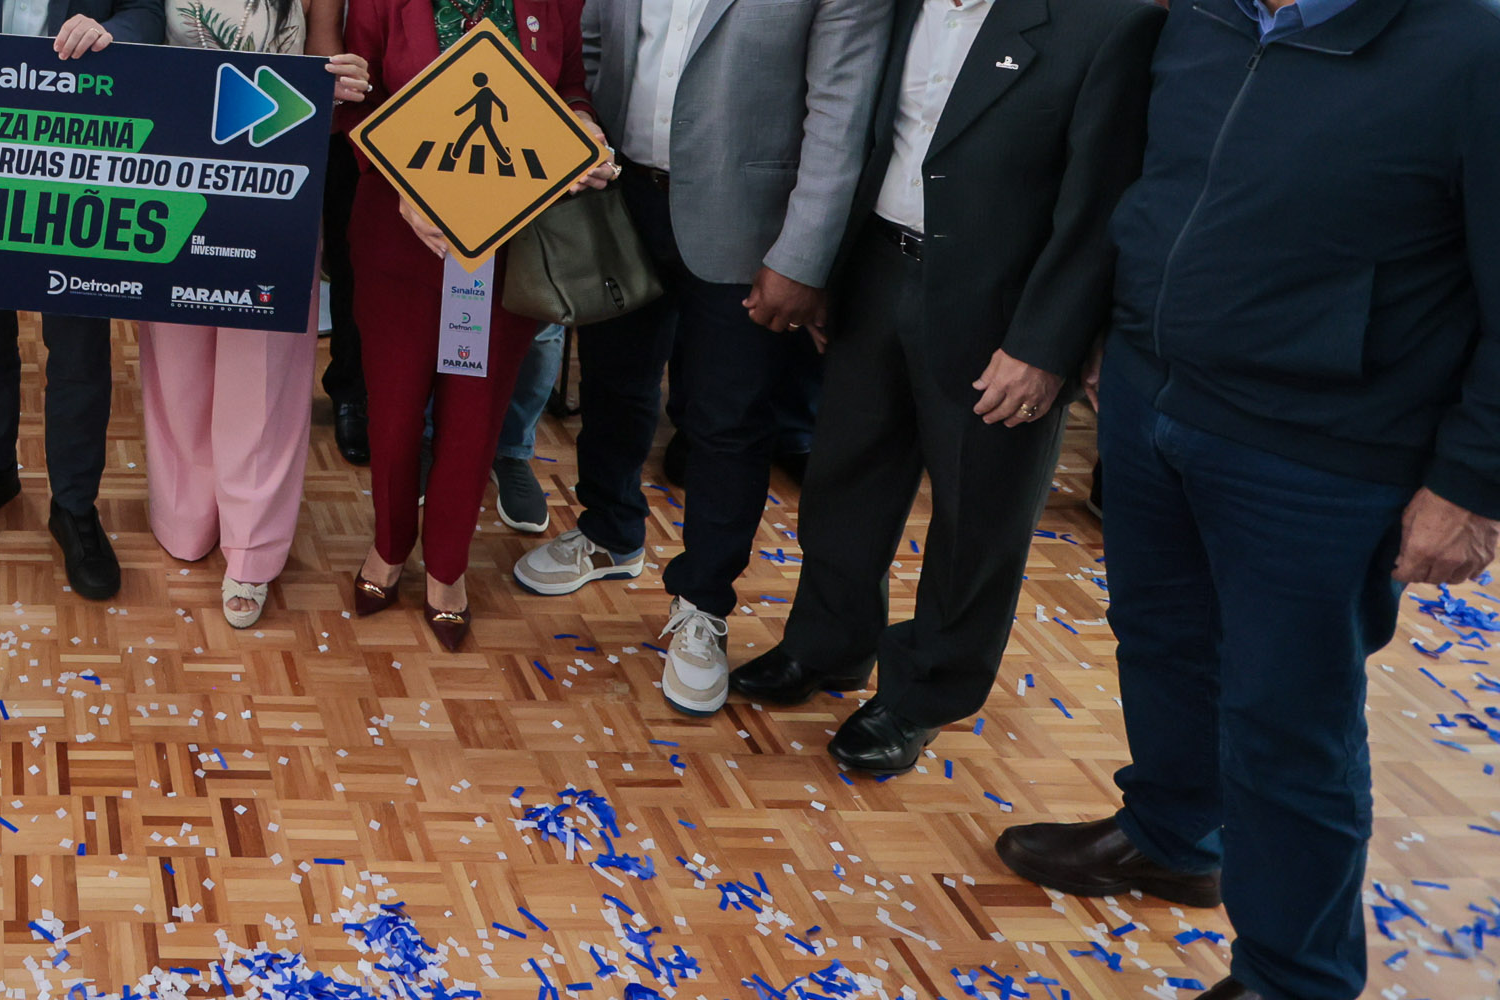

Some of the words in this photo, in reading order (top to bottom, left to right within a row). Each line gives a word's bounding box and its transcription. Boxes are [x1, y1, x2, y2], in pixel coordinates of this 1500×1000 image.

[33, 115, 134, 149] PARANÁ
[69, 152, 102, 181] DE
[107, 155, 172, 187] TODO
[175, 161, 194, 188] O
[197, 163, 295, 195] ESTADO
[191, 235, 206, 245] EM
[190, 245, 257, 259] INVESTIMENTOS
[70, 276, 144, 295] DetranPR
[451, 286, 485, 296] Sinaliza
[171, 286, 253, 305] PARANÁ
[170, 302, 214, 310] GOVERNO
